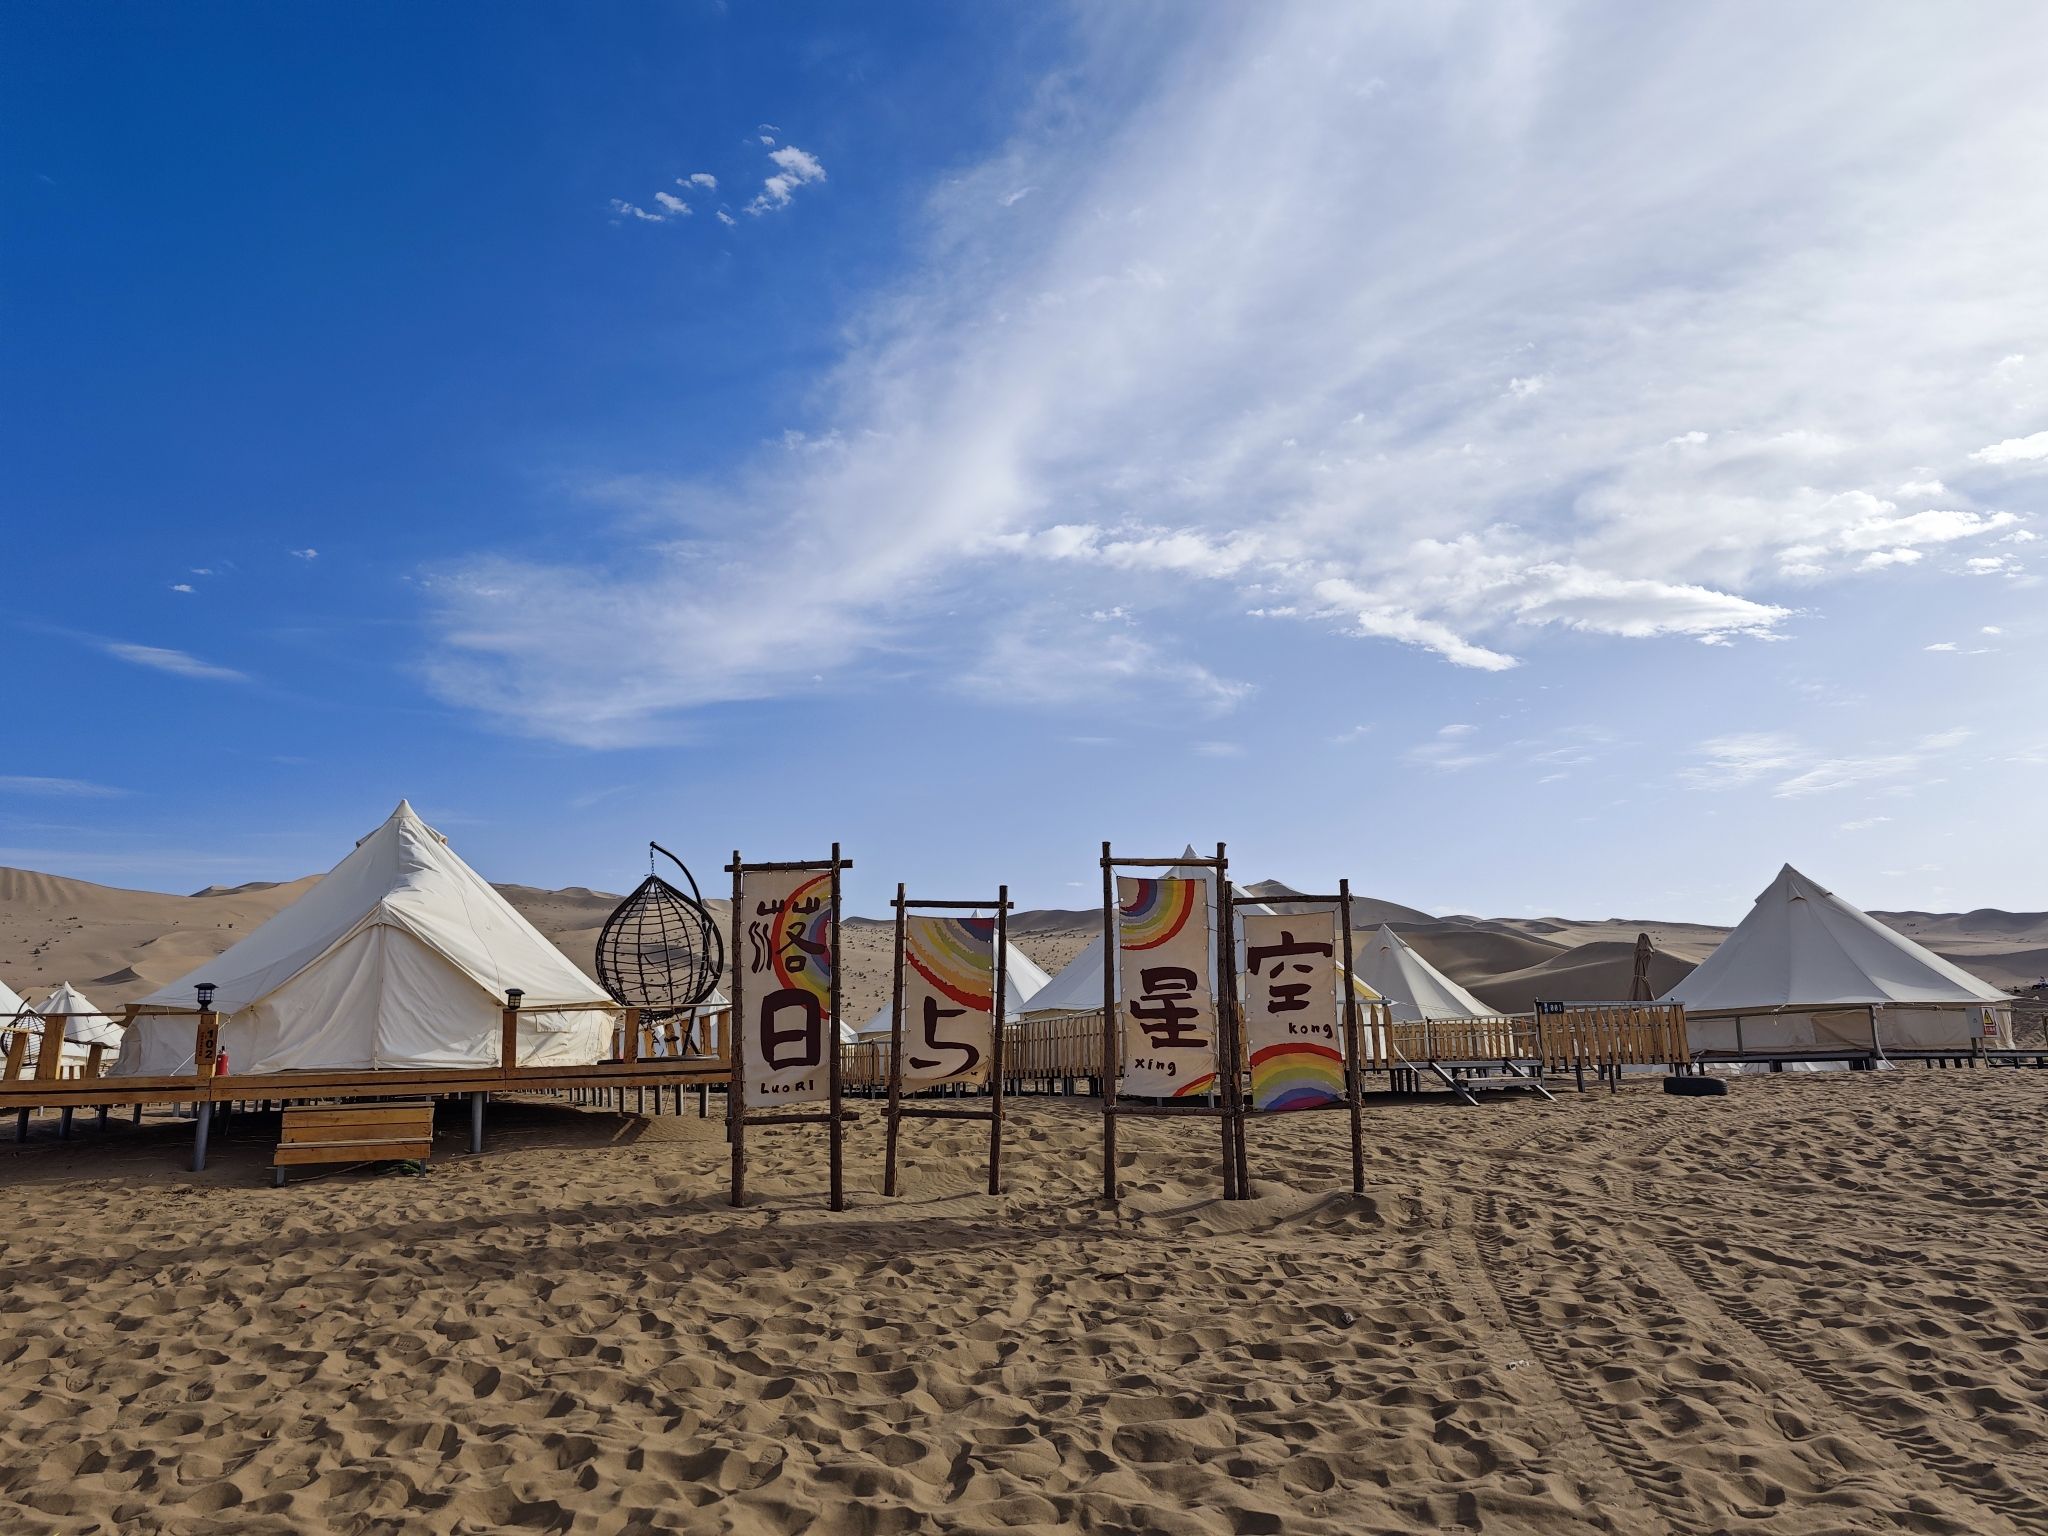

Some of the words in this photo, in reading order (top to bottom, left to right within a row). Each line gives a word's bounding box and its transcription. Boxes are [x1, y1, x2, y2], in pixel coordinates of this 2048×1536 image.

[748, 896, 826, 1071] 落日
[1130, 966, 1208, 1049] 星
[1247, 931, 1334, 1014] 空
[205, 1029, 214, 1059] 102
[909, 995, 979, 1080] 与
